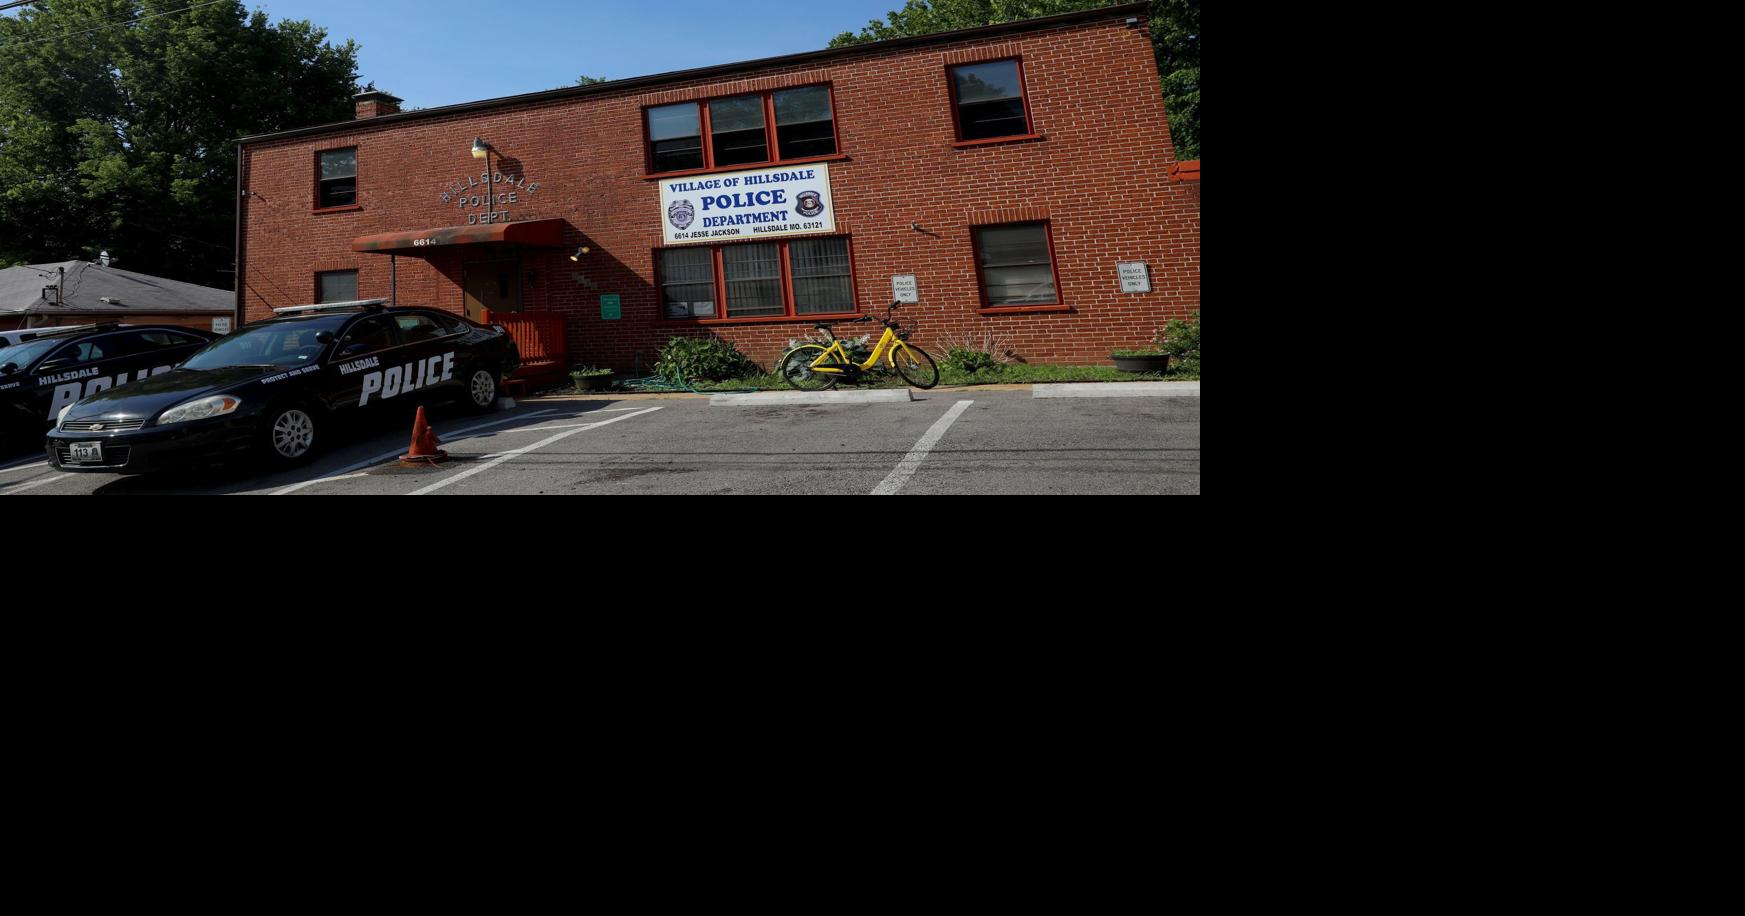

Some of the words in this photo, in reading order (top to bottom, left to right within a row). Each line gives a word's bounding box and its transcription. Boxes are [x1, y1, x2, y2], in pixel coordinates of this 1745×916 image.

[441, 173, 540, 203] HILLSDALE
[670, 179, 720, 193] VILLAGE
[724, 178, 739, 187] OF
[744, 170, 815, 186] HILLSDALE
[459, 192, 517, 208] POLICE
[701, 189, 787, 211] POLICE
[703, 211, 788, 228] DEPARTMENT
[753, 224, 788, 233] HILLSDALE
[803, 222, 823, 230] 63121
[413, 239, 437, 247] 6614
[674, 232, 689, 240] 6614
[690, 230, 710, 239] JESSE
[711, 228, 740, 237] JACKSON
[338, 356, 380, 375] HILLSDALE
[38, 367, 99, 386] HILLSDALE
[260, 372, 289, 384] PROTECT
[358, 351, 455, 407] POLICE
